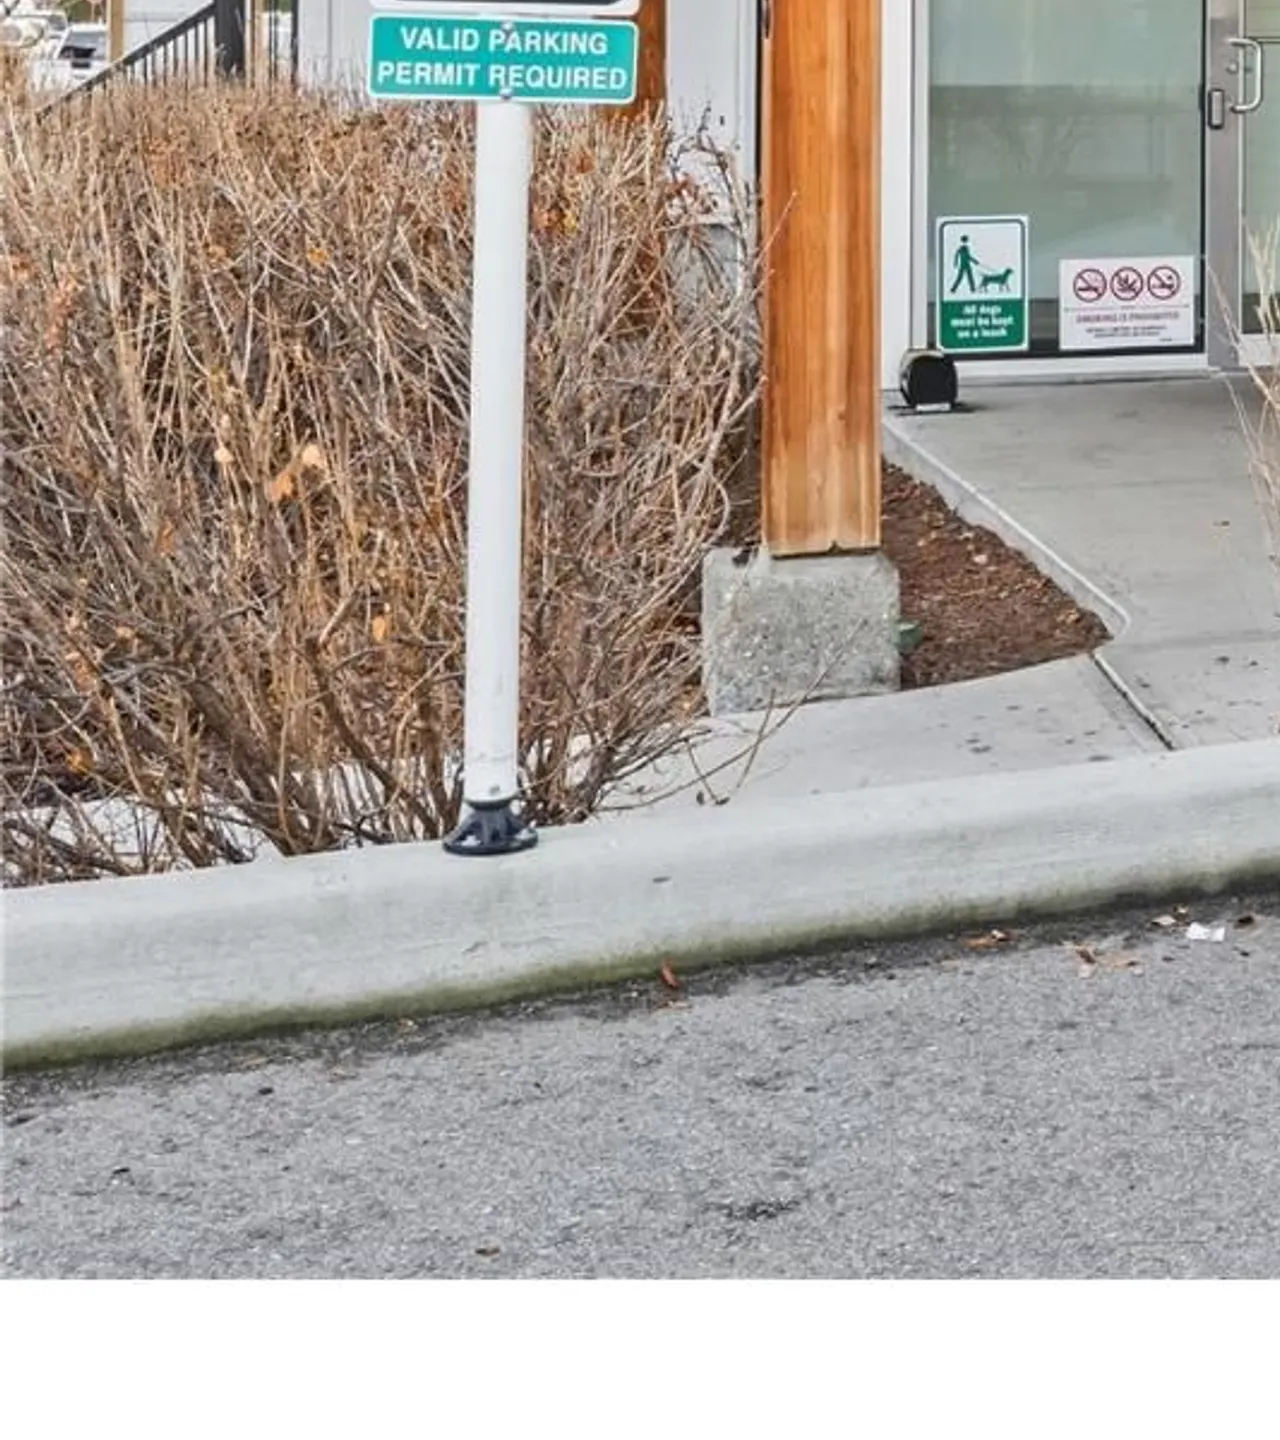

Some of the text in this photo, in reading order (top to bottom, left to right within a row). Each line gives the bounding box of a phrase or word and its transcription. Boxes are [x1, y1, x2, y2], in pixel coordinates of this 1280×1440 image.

[400, 26, 608, 55] VALID PARKING
[377, 61, 628, 90] PERMIT REQUIRED
